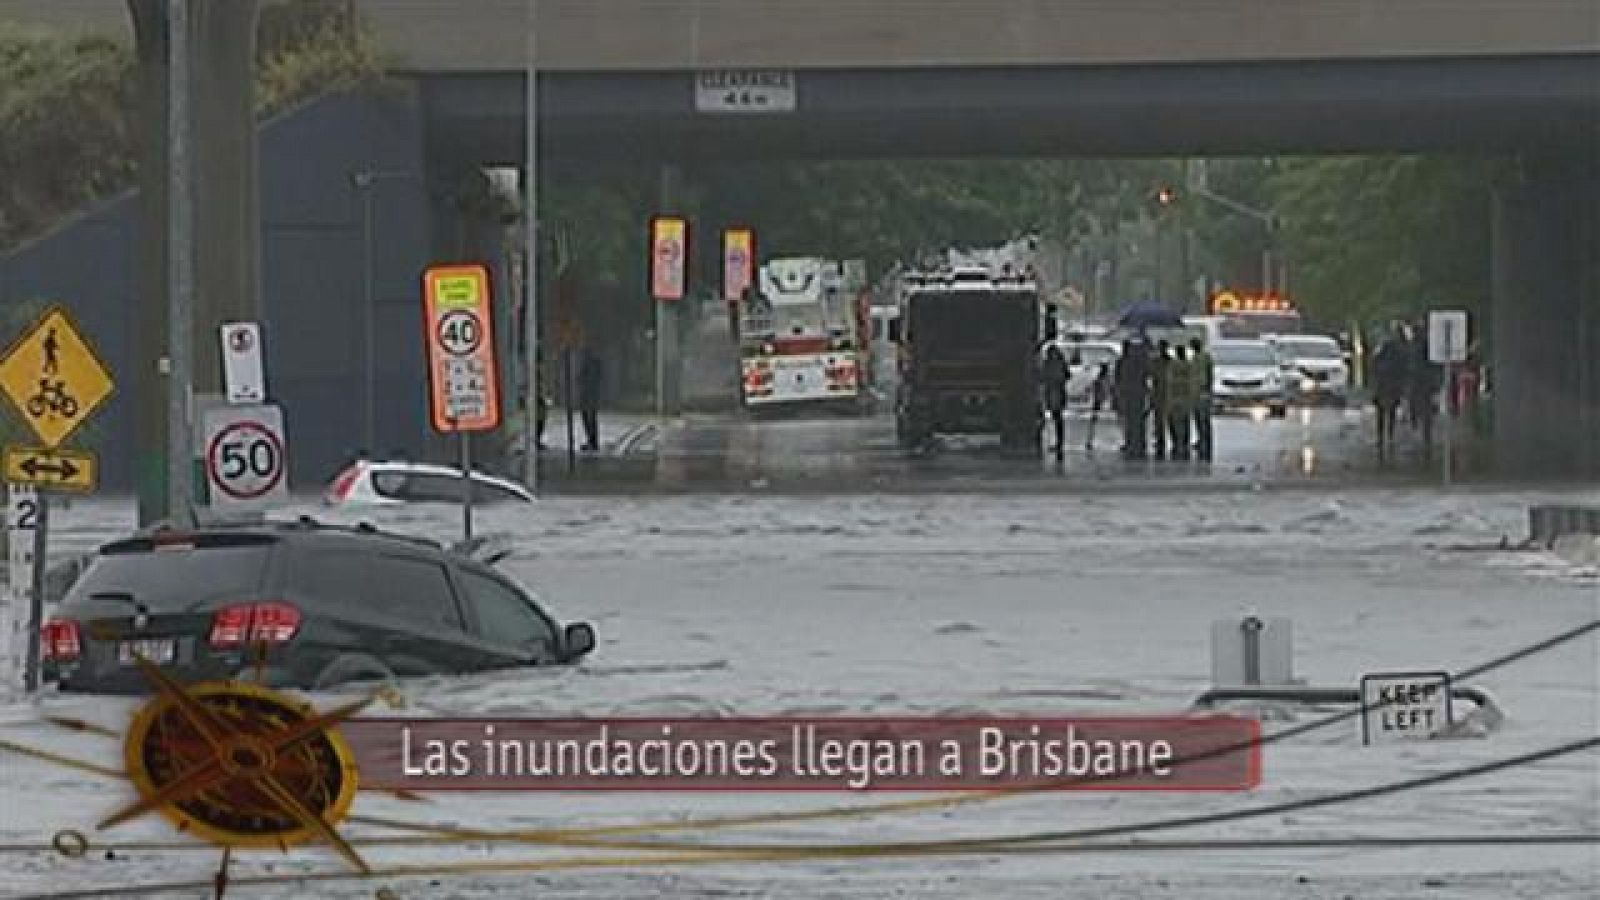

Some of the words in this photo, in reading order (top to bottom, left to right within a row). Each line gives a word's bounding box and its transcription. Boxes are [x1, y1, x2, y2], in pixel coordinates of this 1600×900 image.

[443, 320, 475, 344] 40
[222, 441, 274, 479] 50
[18, 500, 36, 528] 2
[1380, 683, 1436, 704] KEEP
[1382, 709, 1434, 730] LEFT
